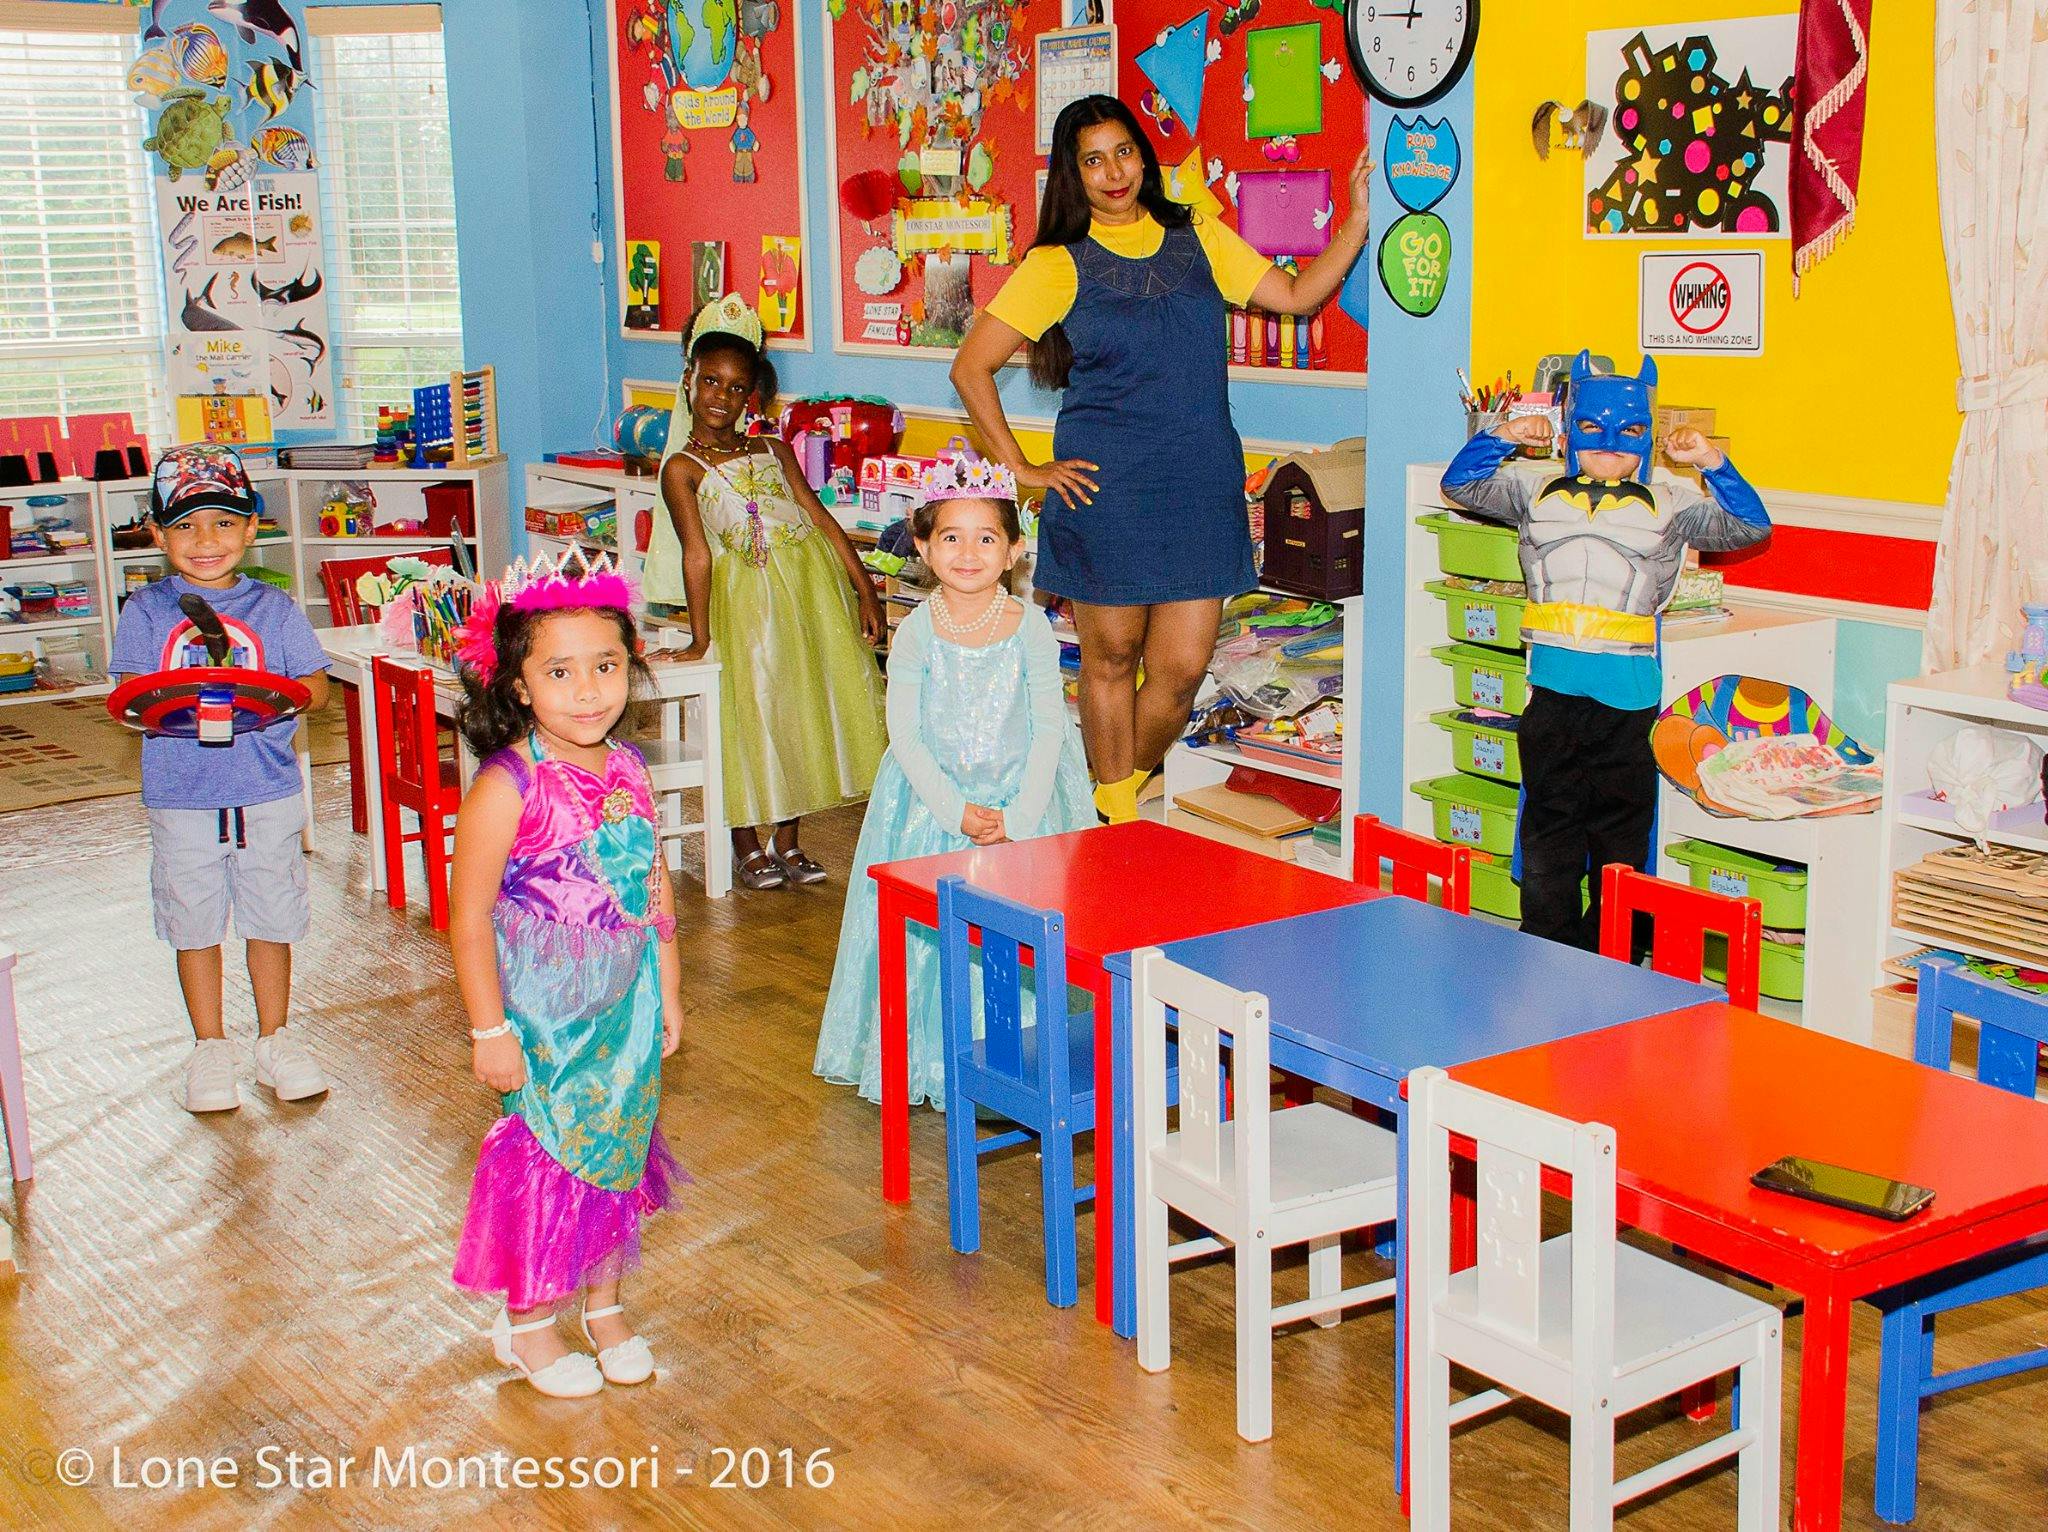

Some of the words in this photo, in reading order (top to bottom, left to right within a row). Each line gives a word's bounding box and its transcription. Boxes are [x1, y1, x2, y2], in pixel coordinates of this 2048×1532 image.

[1367, 6, 1375, 22] 9
[1455, 5, 1463, 22] 3
[1373, 36, 1381, 53] 8
[1445, 37, 1453, 53] 4
[1388, 57, 1395, 73] 7
[1430, 58, 1438, 74] 5
[1407, 66, 1415, 82] 6
[685, 110, 701, 126] the
[1406, 132, 1436, 150] ROAD
[1413, 149, 1428, 164] TO
[1391, 161, 1451, 181] KNOWLEDGE
[176, 195, 210, 212] We
[216, 195, 250, 212] Are
[258, 193, 303, 211] Fish!
[924, 220, 943, 231] STAR
[1400, 231, 1442, 259] GO
[1402, 257, 1441, 278] FOR
[1408, 278, 1437, 298] IT!
[1675, 283, 1728, 309] WHINING
[884, 304, 899, 315] STAR
[206, 339, 242, 353] Mike
[1649, 334, 1665, 344] THIS
[1666, 335, 1674, 344] IS
[1675, 335, 1681, 344] A
[1682, 335, 1694, 344] NO
[1696, 335, 1729, 345] WHINING
[1730, 335, 1752, 345] ZONE
